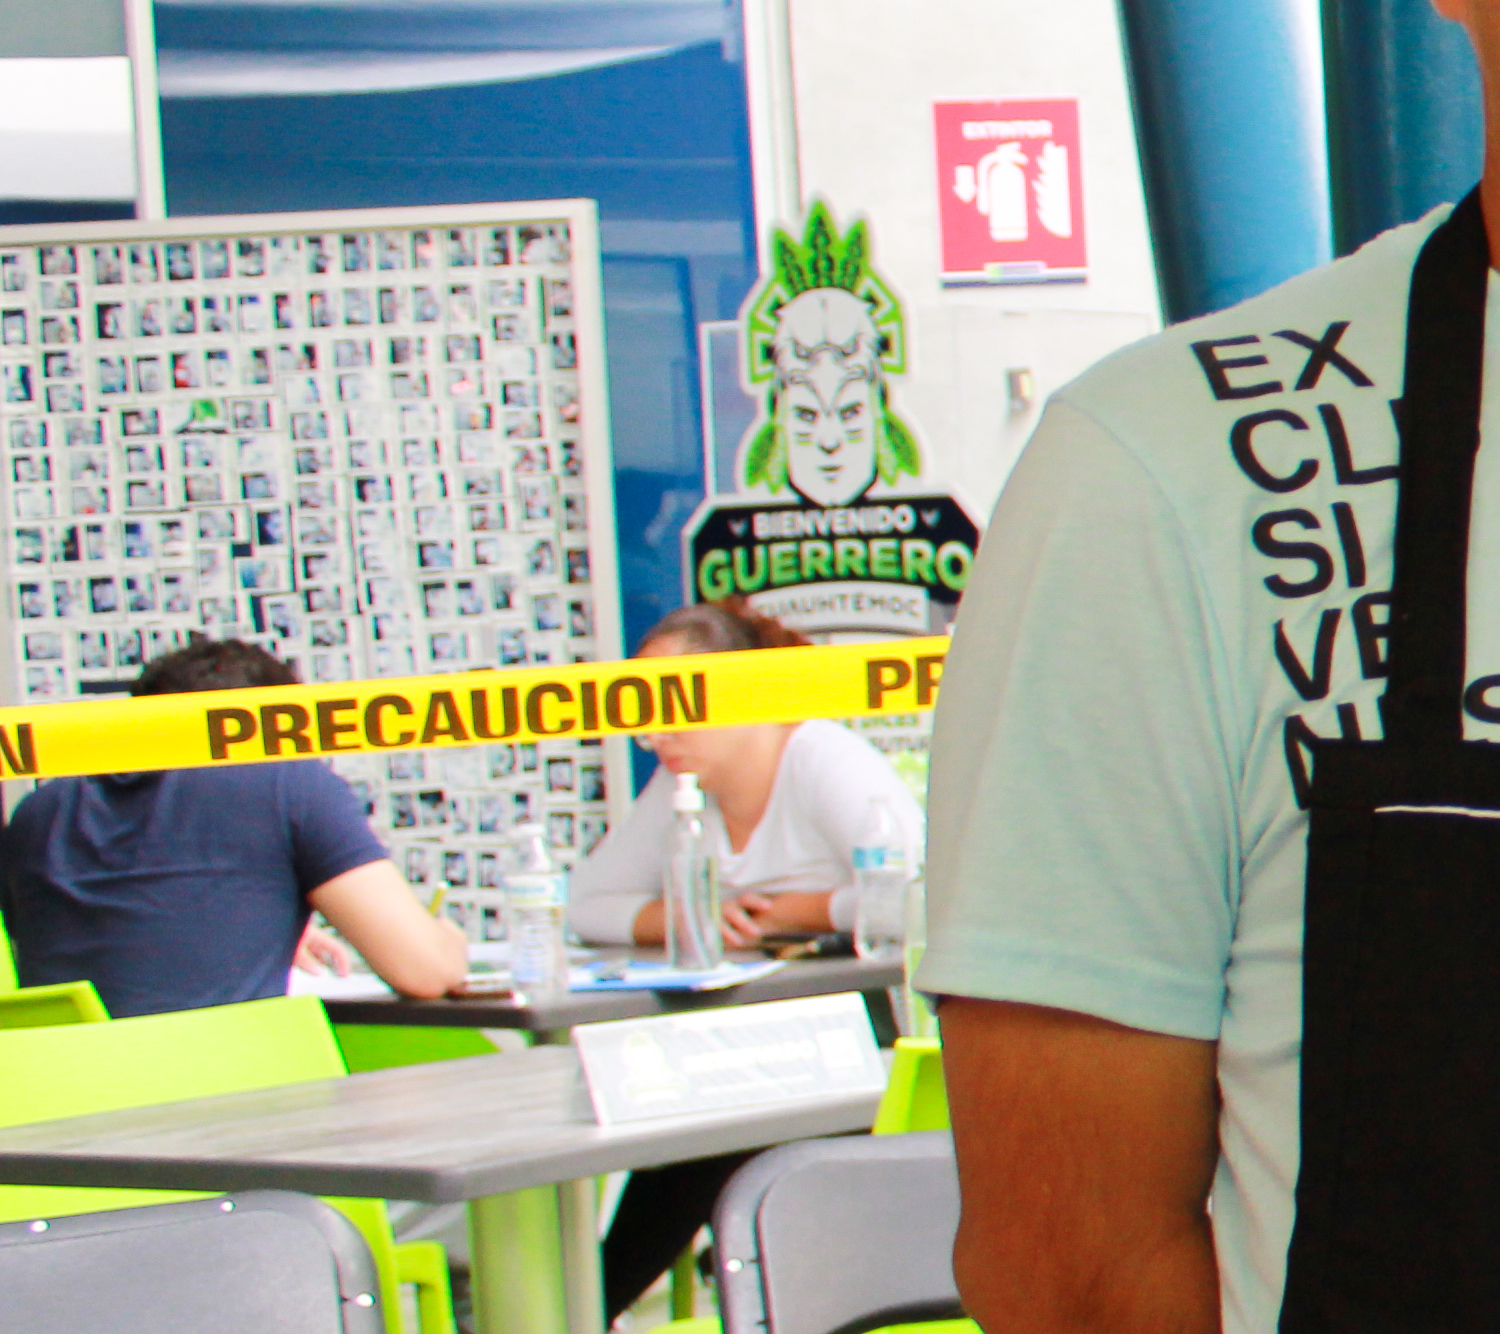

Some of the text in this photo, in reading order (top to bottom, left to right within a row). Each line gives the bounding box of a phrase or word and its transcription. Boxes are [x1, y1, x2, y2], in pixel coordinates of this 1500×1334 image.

[1190, 320, 1376, 401] EX
[1229, 396, 1405, 494] CL
[752, 504, 917, 539] BIENVENIDO
[1251, 500, 1367, 599] SI
[699, 537, 976, 603] GUERRERO
[206, 672, 708, 762] PRECAUCION
